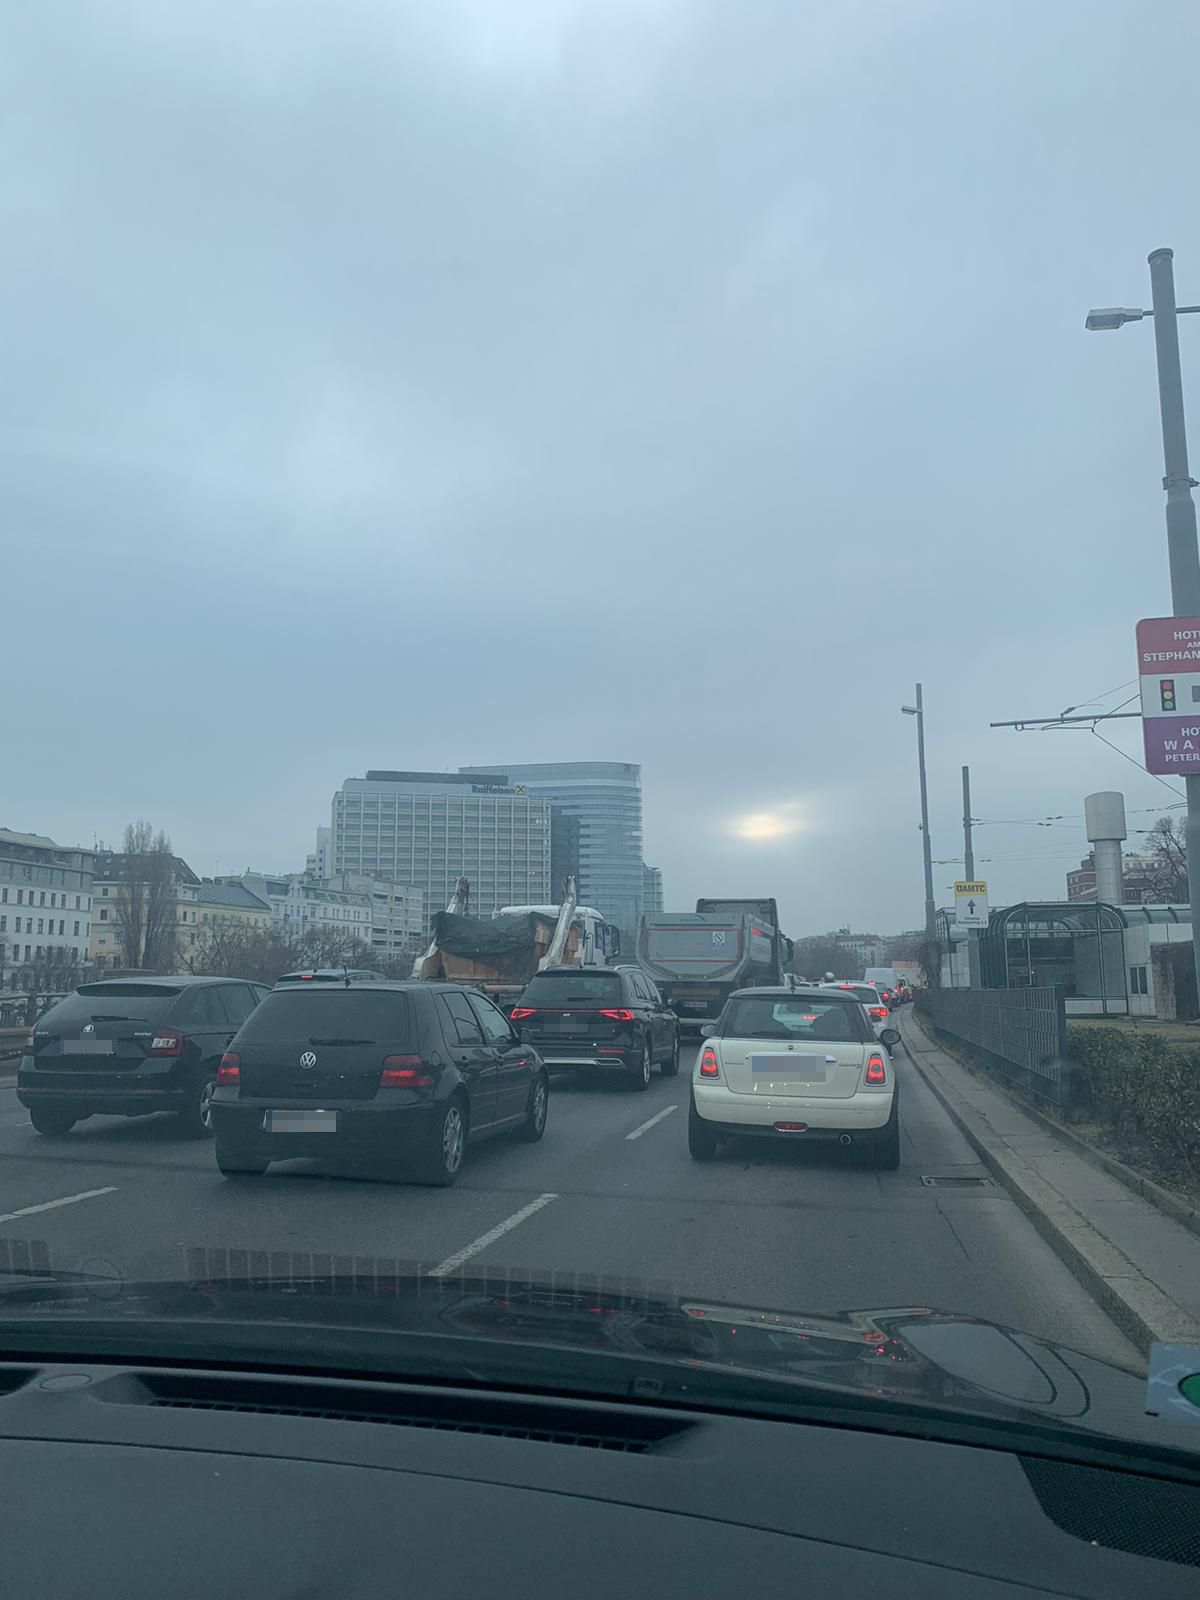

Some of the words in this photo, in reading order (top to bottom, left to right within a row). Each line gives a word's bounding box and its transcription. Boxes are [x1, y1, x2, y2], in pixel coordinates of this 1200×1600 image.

[1173, 631, 1200, 640] HOT
[1181, 727, 1200, 737] HO
[471, 784, 515, 795] Raiffeisen
